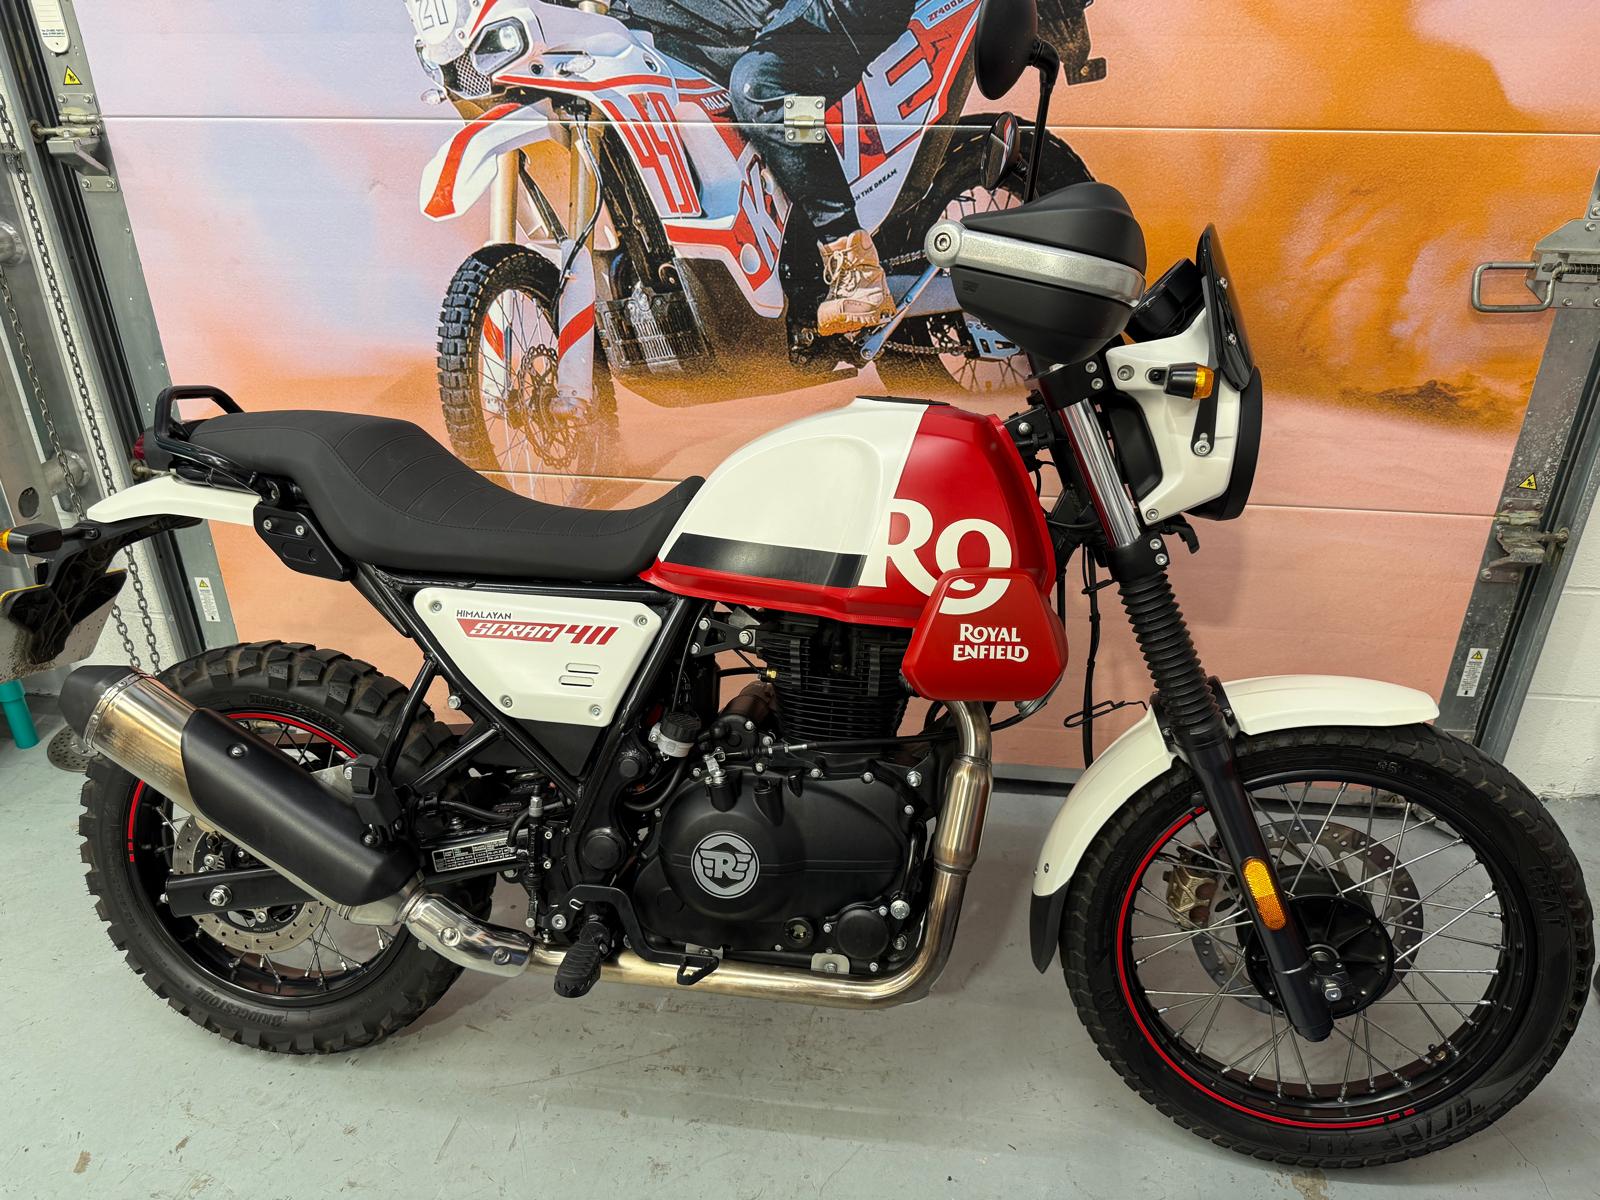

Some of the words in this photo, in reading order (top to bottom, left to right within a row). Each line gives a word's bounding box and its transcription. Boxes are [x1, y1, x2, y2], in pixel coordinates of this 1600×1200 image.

[860, 185, 873, 197] THE
[873, 168, 897, 188] DREAM
[456, 609, 512, 620] HIMALAYAN
[470, 622, 560, 639] SCRAM
[564, 624, 619, 645] 411
[959, 623, 1021, 643] ROYAL
[953, 645, 1029, 662] ENFIELD
